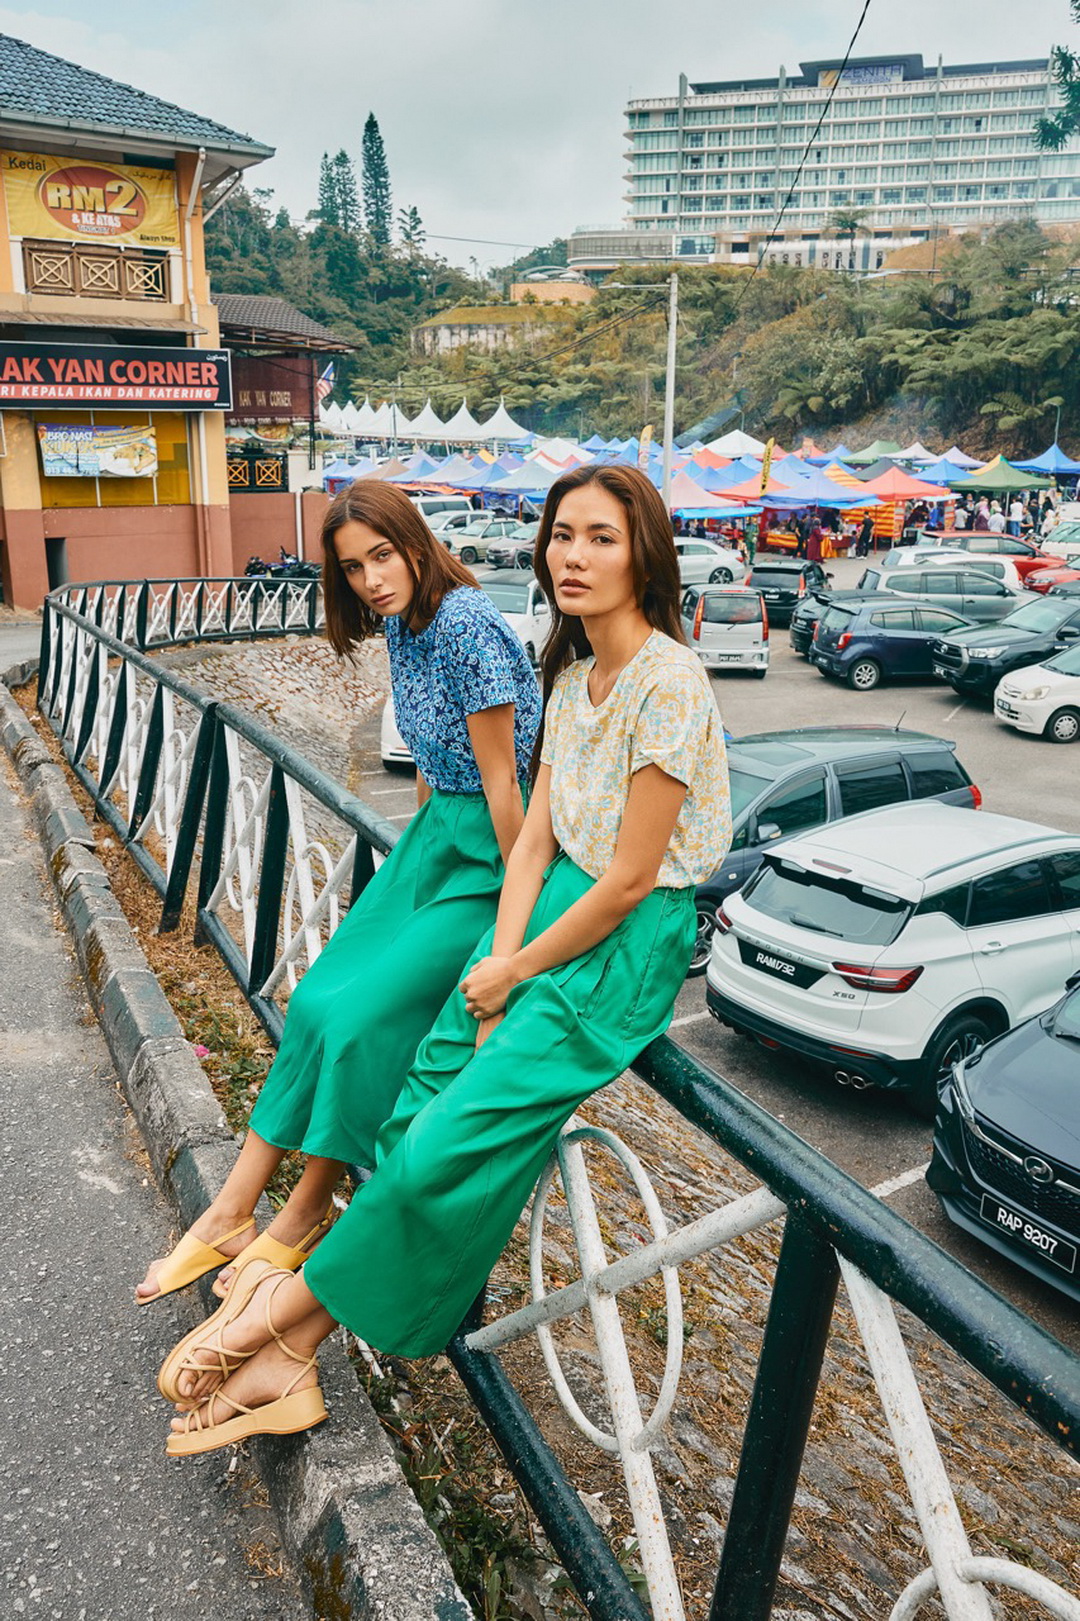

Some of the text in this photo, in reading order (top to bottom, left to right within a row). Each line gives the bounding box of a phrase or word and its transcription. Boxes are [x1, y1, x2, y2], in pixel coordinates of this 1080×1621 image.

[842, 64, 902, 79] ZENITH
[8, 156, 46, 171] Kedai
[46, 180, 138, 217] RM2
[71, 212, 121, 228] & KE ATAS
[0, 357, 219, 385] AK YAN CORNER
[0, 386, 212, 399] RI KEPALA IKAN DAN KATERING
[269, 391, 292, 407] CORNER
[746, 936, 804, 962] PROTON
[832, 990, 856, 1000] X50
[997, 1207, 1058, 1254] RAP 9207
